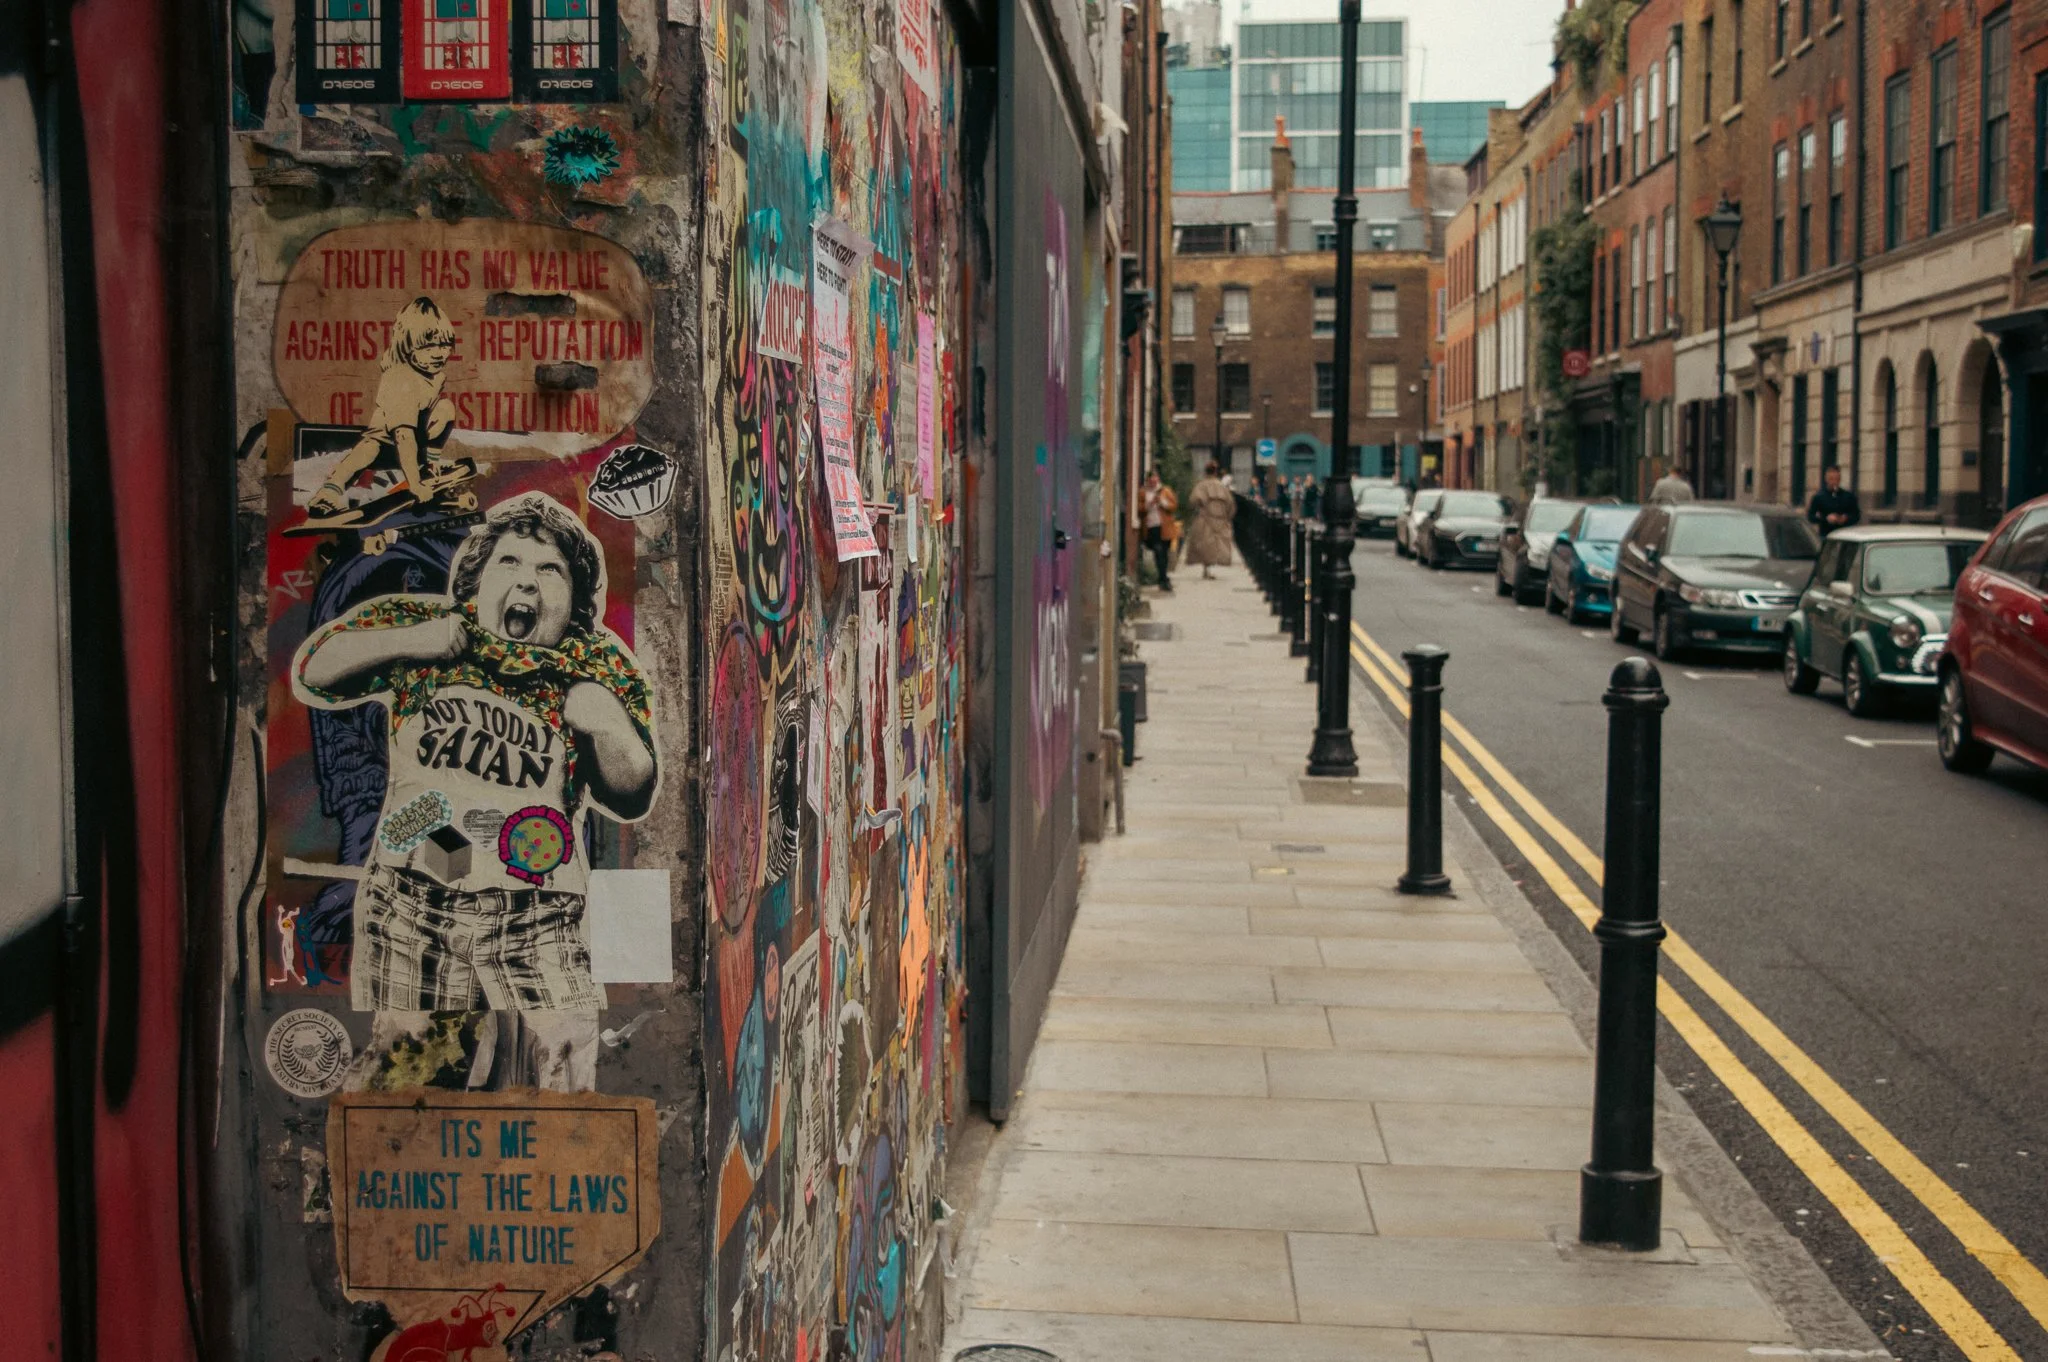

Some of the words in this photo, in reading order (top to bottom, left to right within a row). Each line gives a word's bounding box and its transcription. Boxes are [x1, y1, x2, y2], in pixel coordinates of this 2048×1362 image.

[321, 249, 405, 290] TRUTH
[420, 249, 471, 290] HAS
[483, 249, 517, 290] NO
[529, 249, 609, 291] VALUE
[480, 320, 643, 361] REPUTATION
[329, 391, 364, 425] OF
[422, 697, 471, 731] NOT
[474, 700, 554, 754] TODAY
[416, 725, 554, 789] SATAN
[274, 1015, 302, 1036] SECRET
[304, 1012, 338, 1032] SOCIETY
[440, 1119, 482, 1158] ITS
[500, 1119, 537, 1159] ME
[356, 1170, 463, 1210] AGAINST
[481, 1172, 532, 1212] THE
[549, 1174, 628, 1214] LAWS
[415, 1223, 448, 1262] OF
[468, 1223, 574, 1265] NATURE
